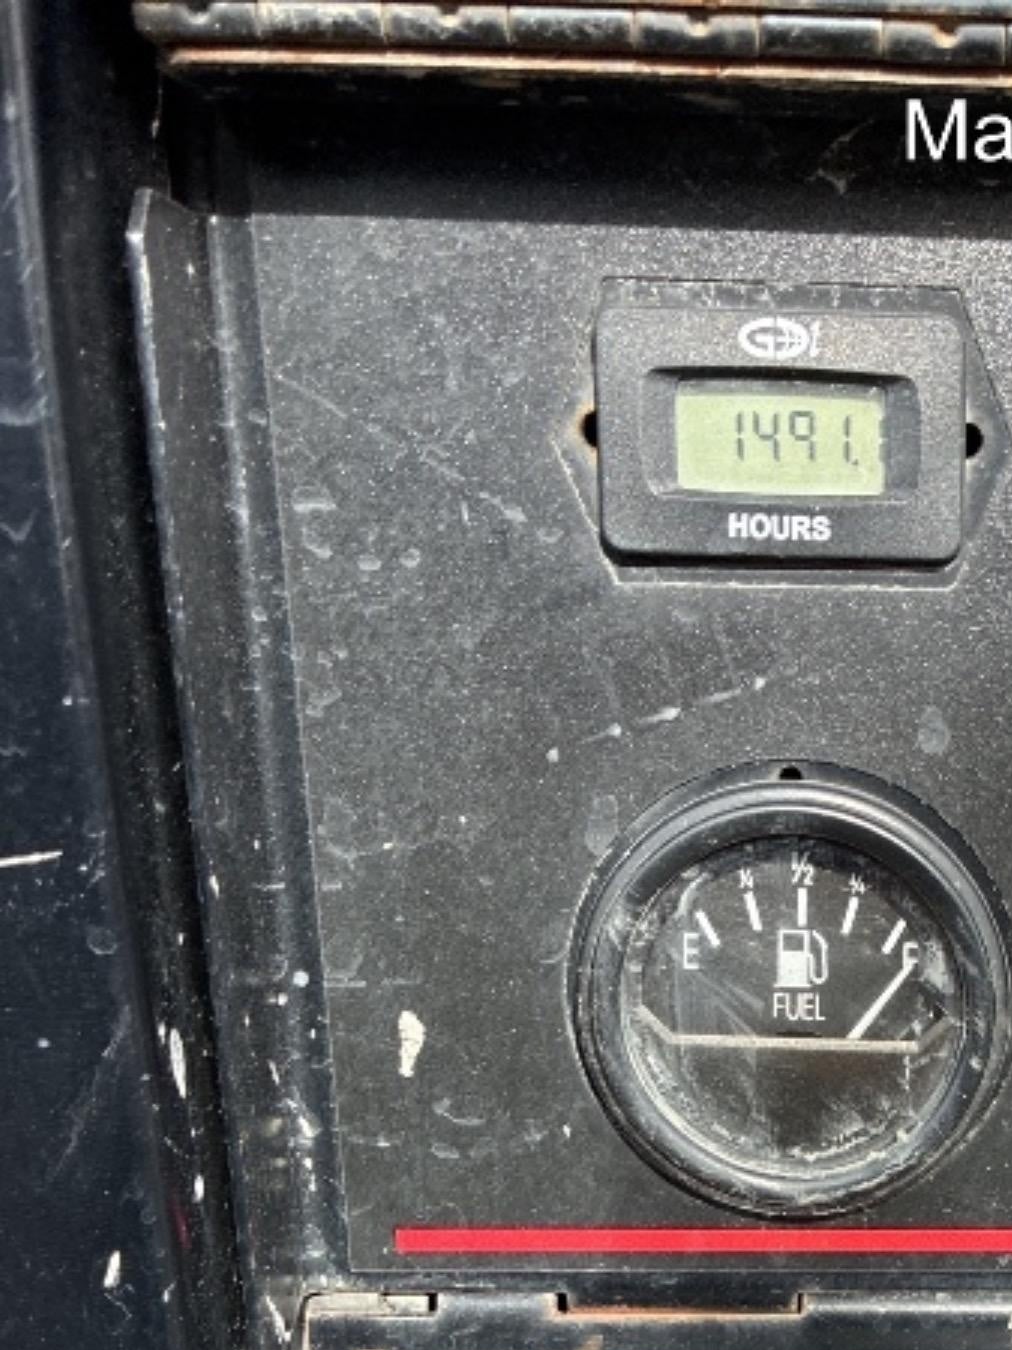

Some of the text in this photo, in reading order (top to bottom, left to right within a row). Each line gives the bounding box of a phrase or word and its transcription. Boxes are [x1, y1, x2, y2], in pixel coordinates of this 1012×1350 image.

[727, 512, 832, 542] HOURS
[683, 932, 700, 970] E
[772, 991, 826, 1022] FUEL
